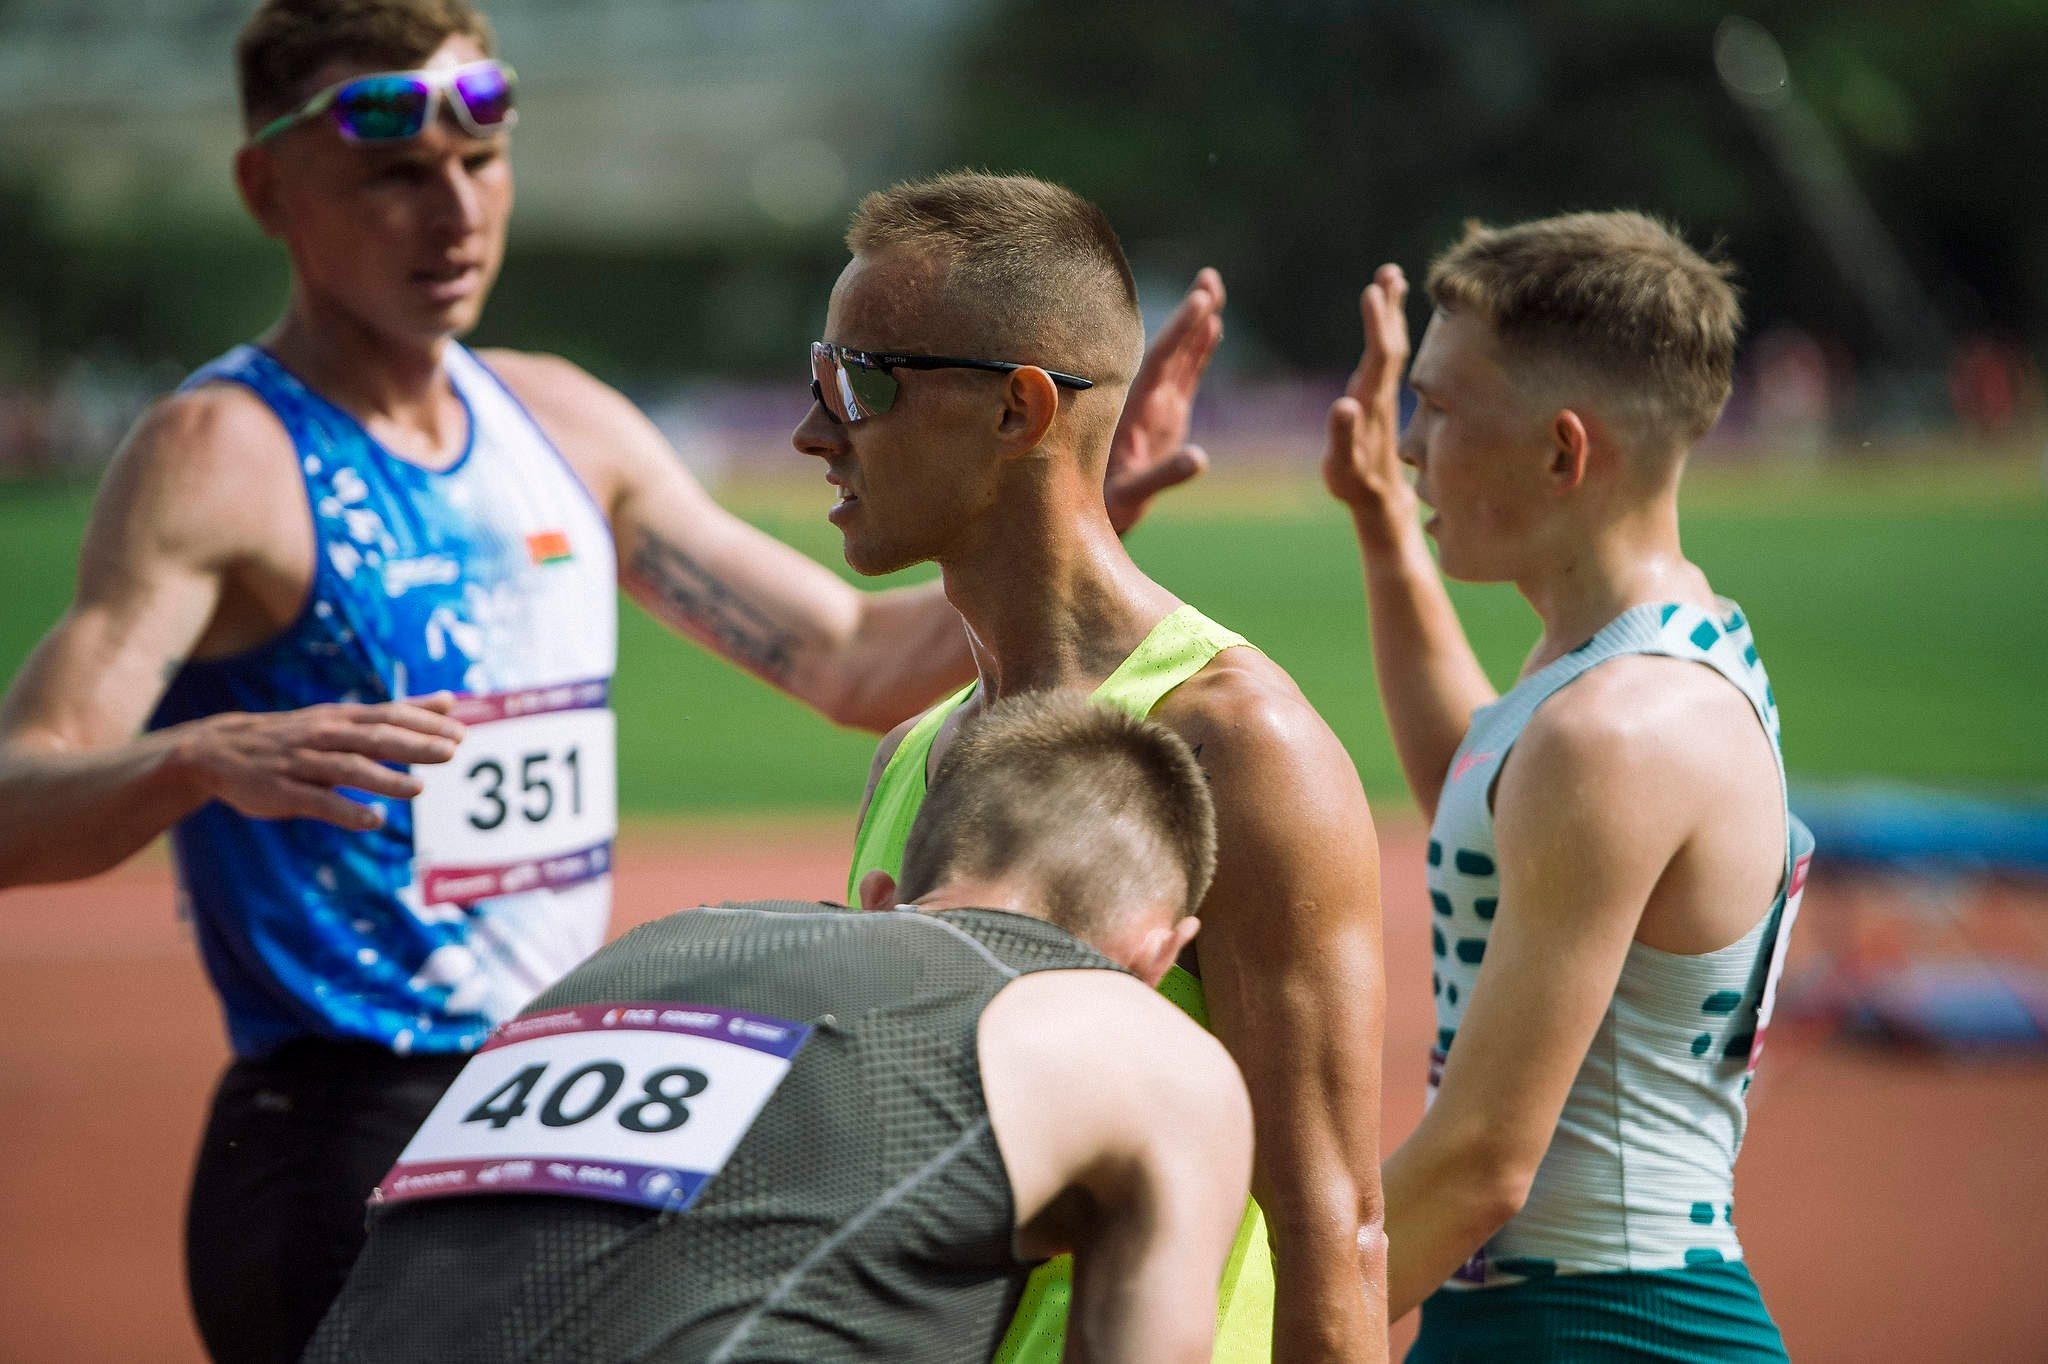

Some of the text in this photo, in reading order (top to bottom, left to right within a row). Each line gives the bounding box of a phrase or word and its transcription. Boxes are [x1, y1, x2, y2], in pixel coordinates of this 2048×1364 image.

[884, 356, 907, 364] SMITH
[467, 748, 582, 831] 351
[463, 1061, 709, 1134] 408
